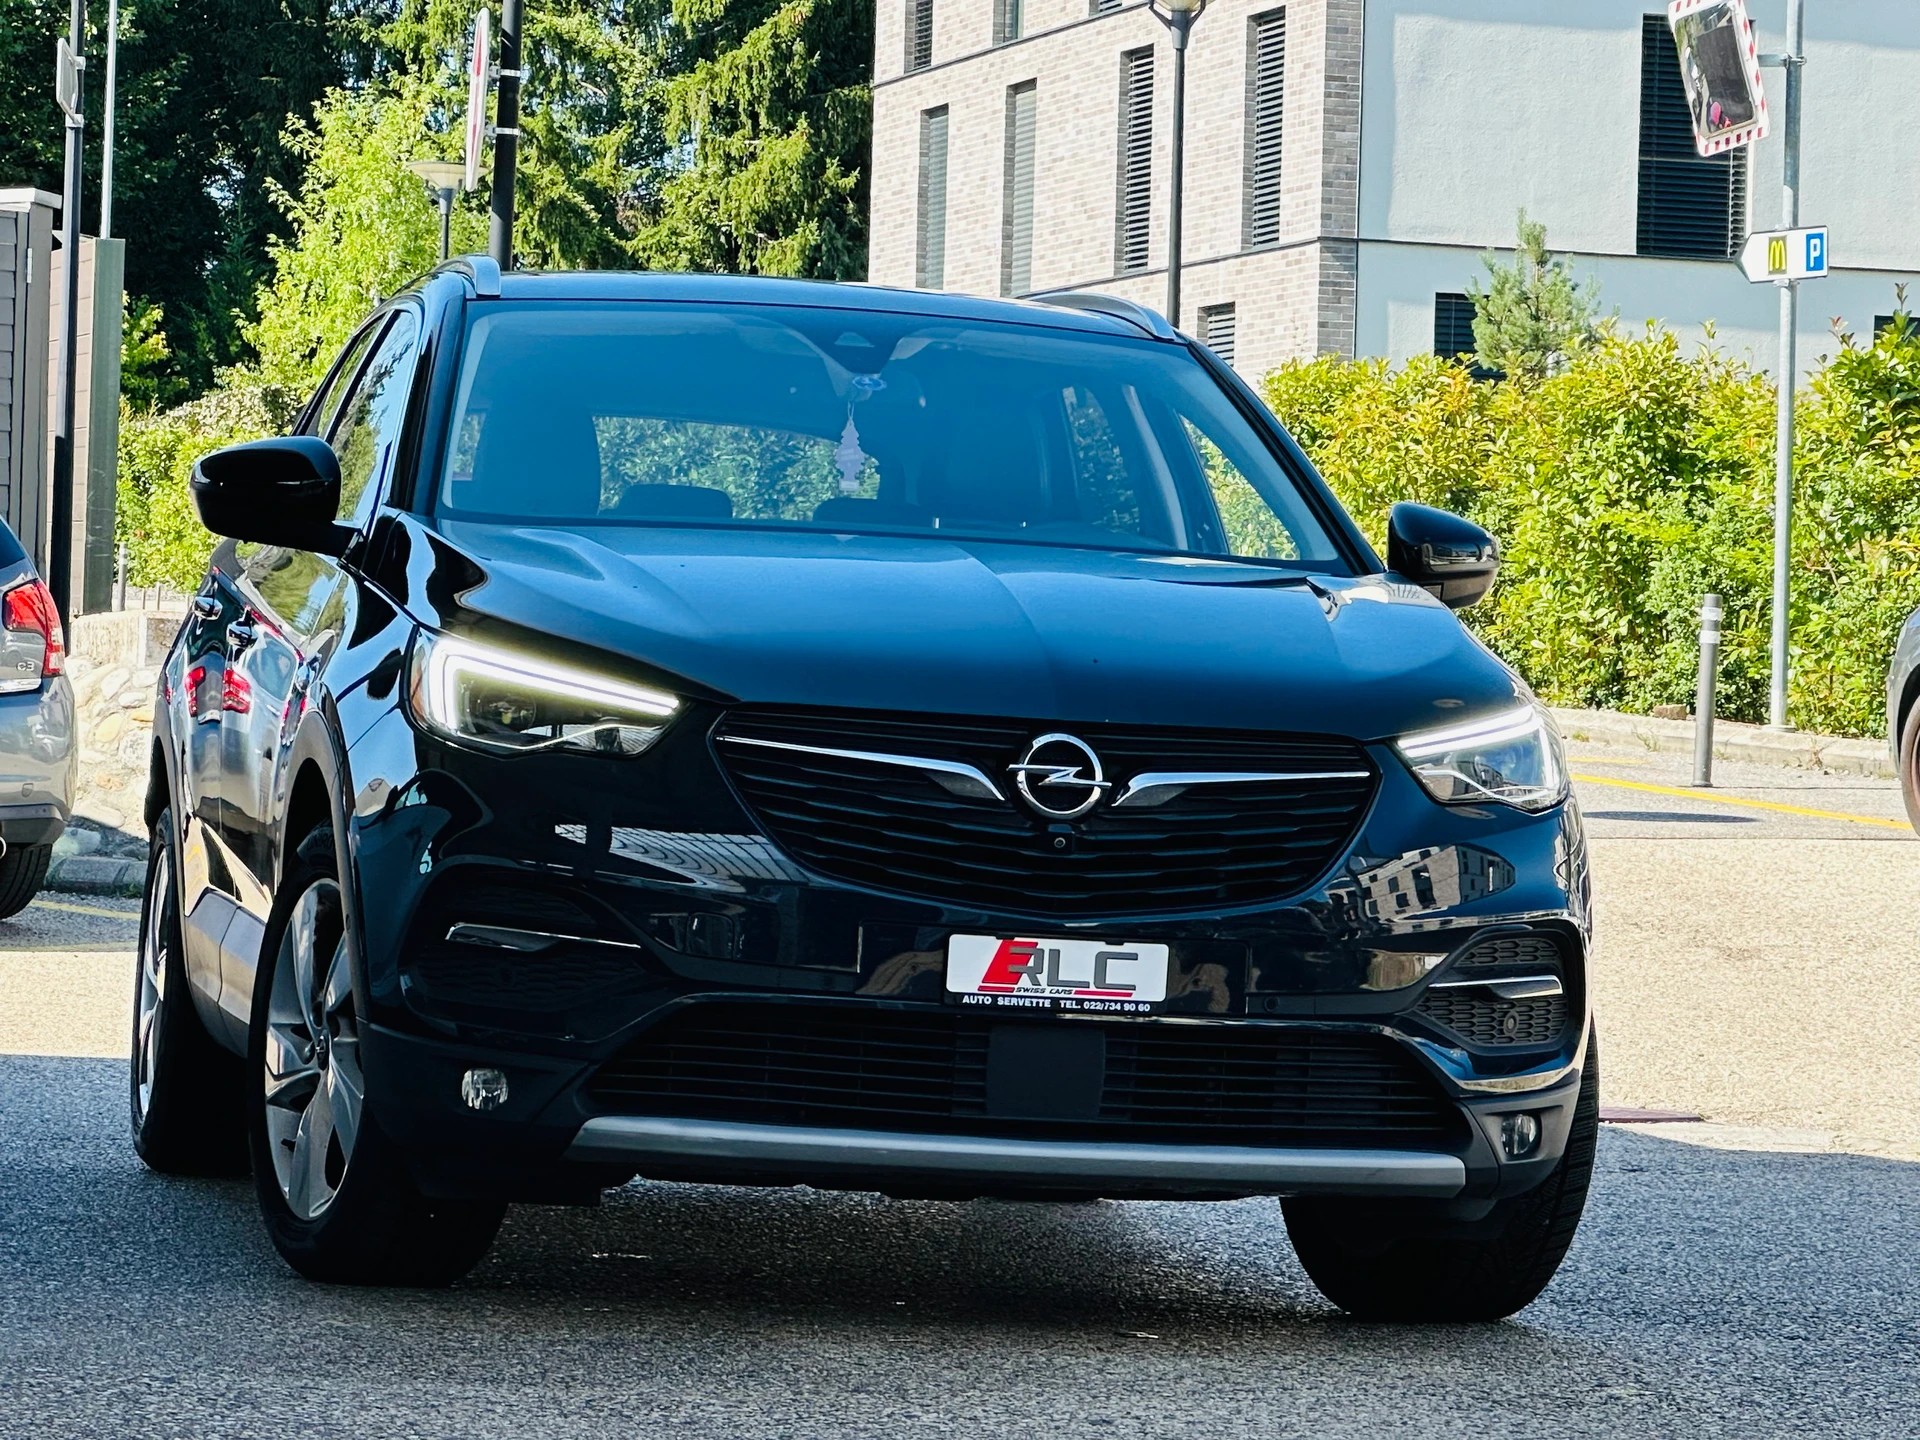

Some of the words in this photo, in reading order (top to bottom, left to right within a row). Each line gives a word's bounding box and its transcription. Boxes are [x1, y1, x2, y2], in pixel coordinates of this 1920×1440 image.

[1810, 238, 1821, 268] P
[962, 995, 992, 1005] AUTO
[997, 997, 1051, 1007] SERVETTE
[1059, 1000, 1081, 1009] TEL.
[1083, 1001, 1121, 1011] 022/734
[1123, 1003, 1136, 1011] 90
[1138, 1003, 1151, 1012] 60
